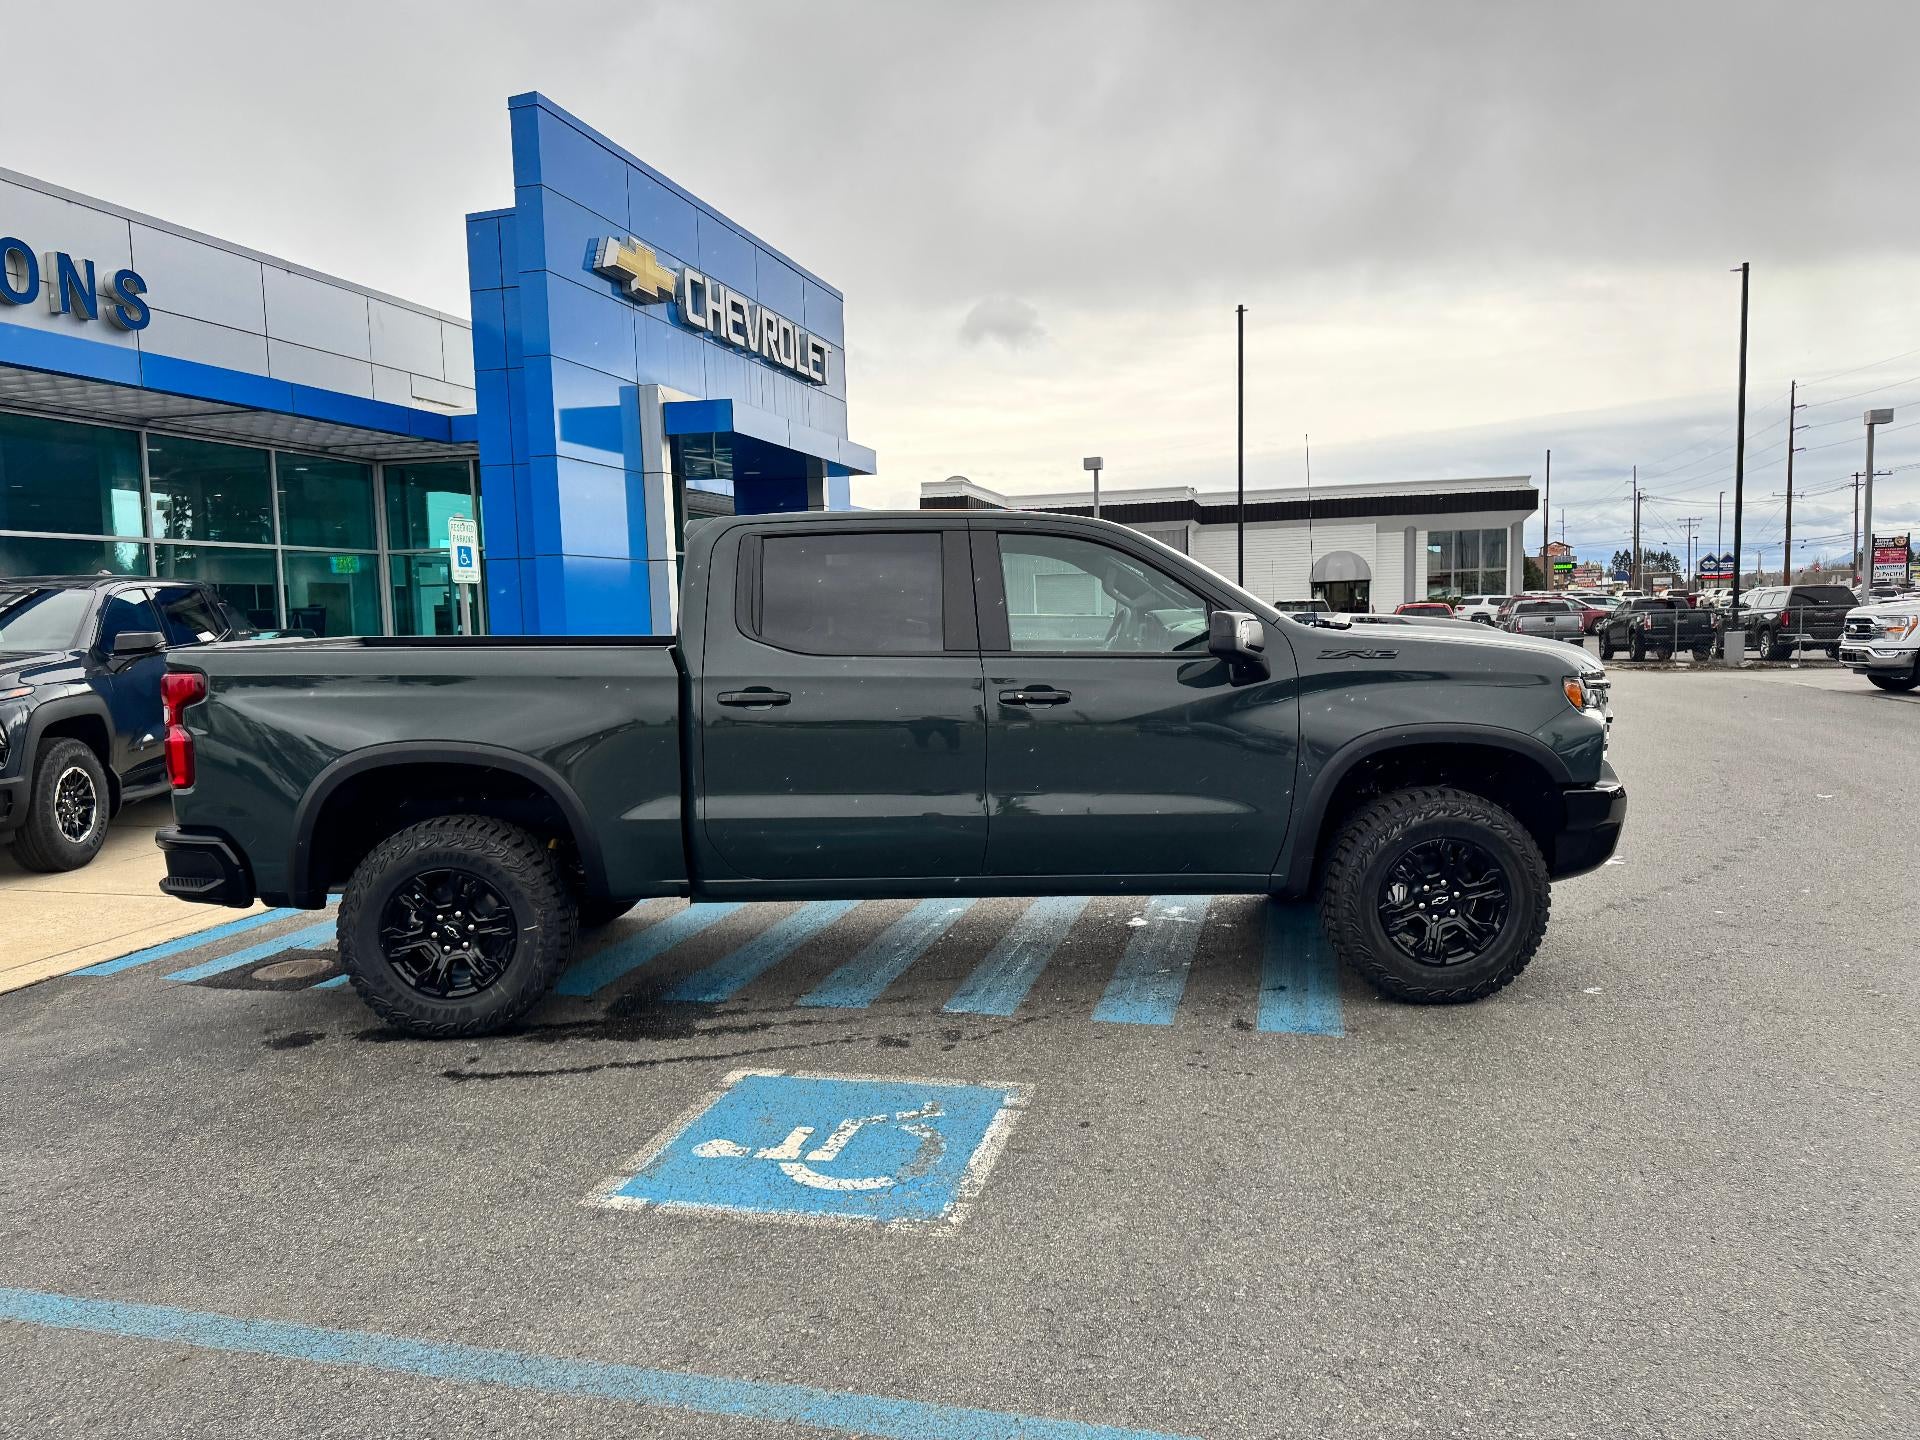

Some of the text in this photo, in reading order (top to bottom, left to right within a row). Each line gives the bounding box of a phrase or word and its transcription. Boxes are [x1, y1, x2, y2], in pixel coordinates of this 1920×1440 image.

[683, 267, 833, 386] CHEVROLET
[451, 523, 474, 533] RESERVED
[453, 534, 474, 544] PARKING
